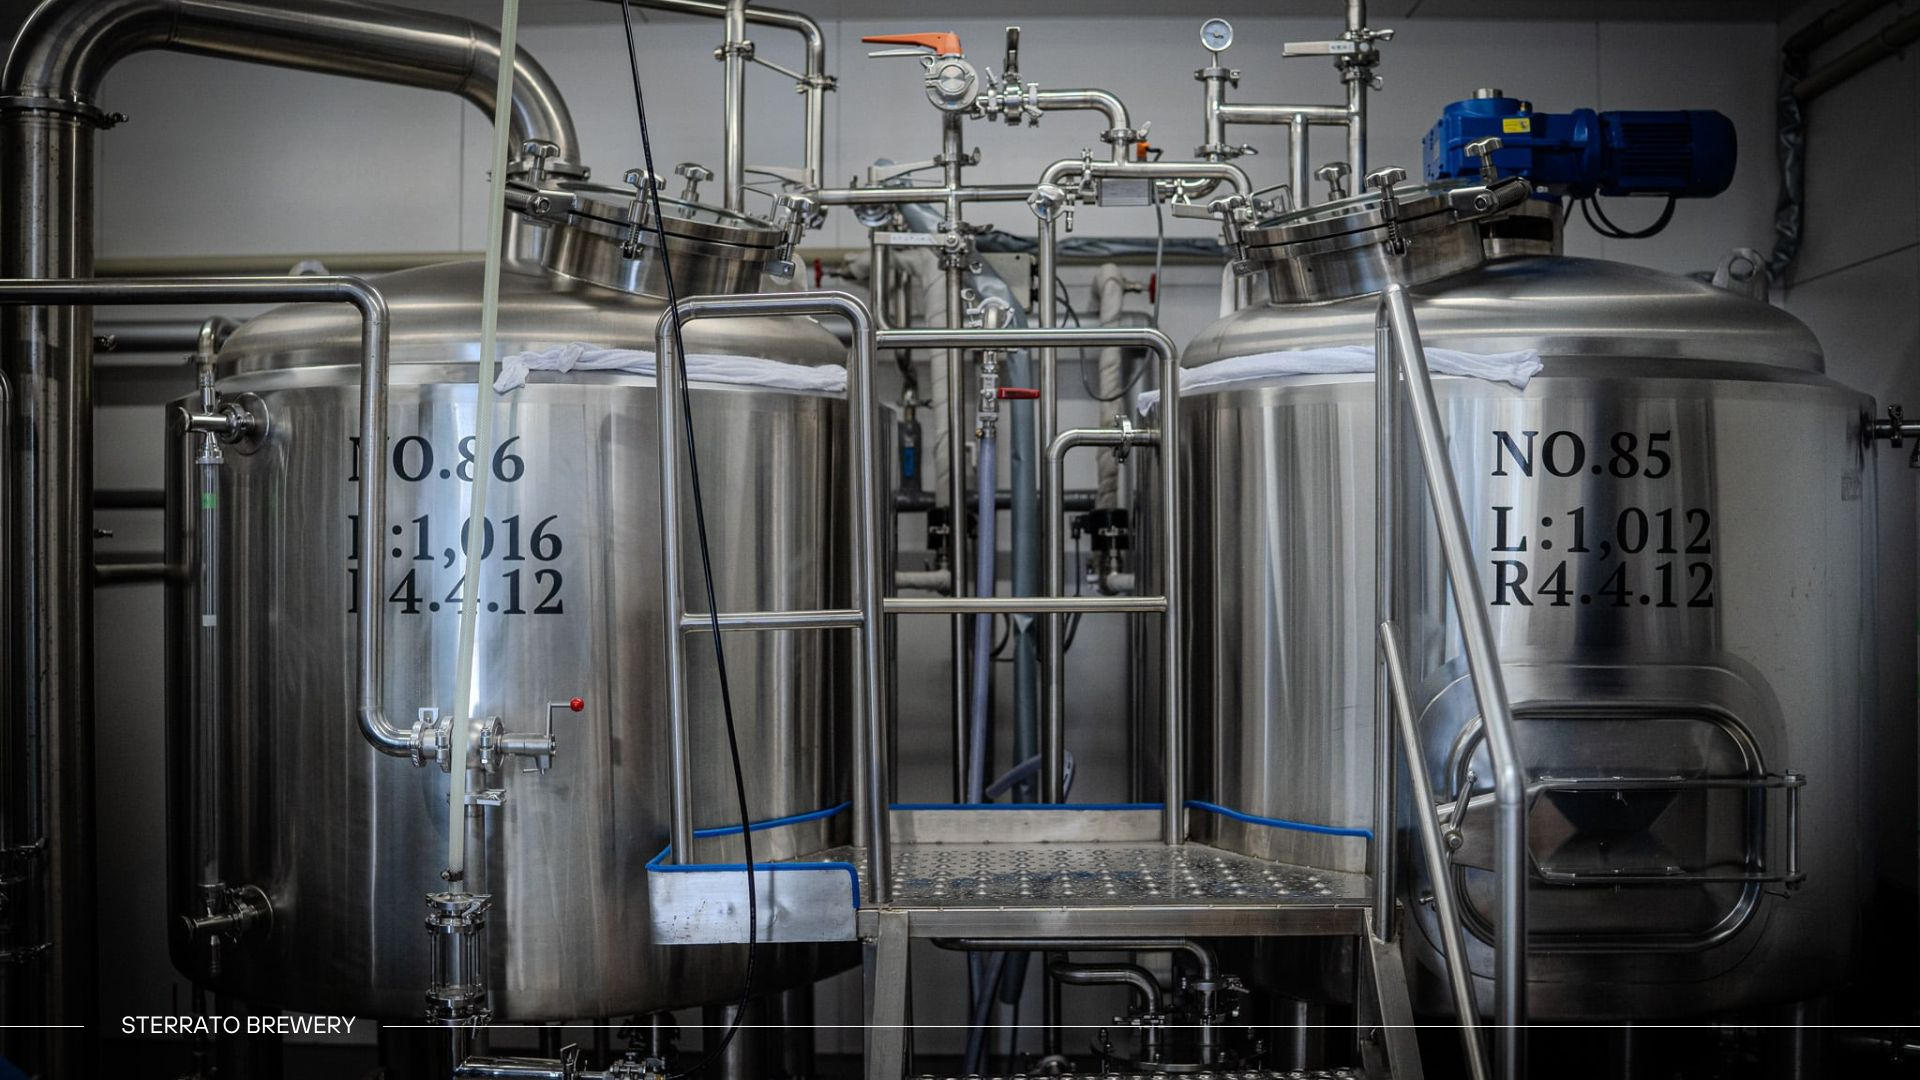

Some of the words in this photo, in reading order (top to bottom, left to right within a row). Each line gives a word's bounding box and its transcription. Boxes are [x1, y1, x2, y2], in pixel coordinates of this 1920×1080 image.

[348, 435, 525, 483] O.86
[1491, 430, 1672, 479] NO.85
[347, 514, 563, 569] :1,016
[1491, 506, 1711, 561] L:1,012
[347, 568, 564, 615] 4.4.12
[1490, 559, 1714, 608] R4.4.12
